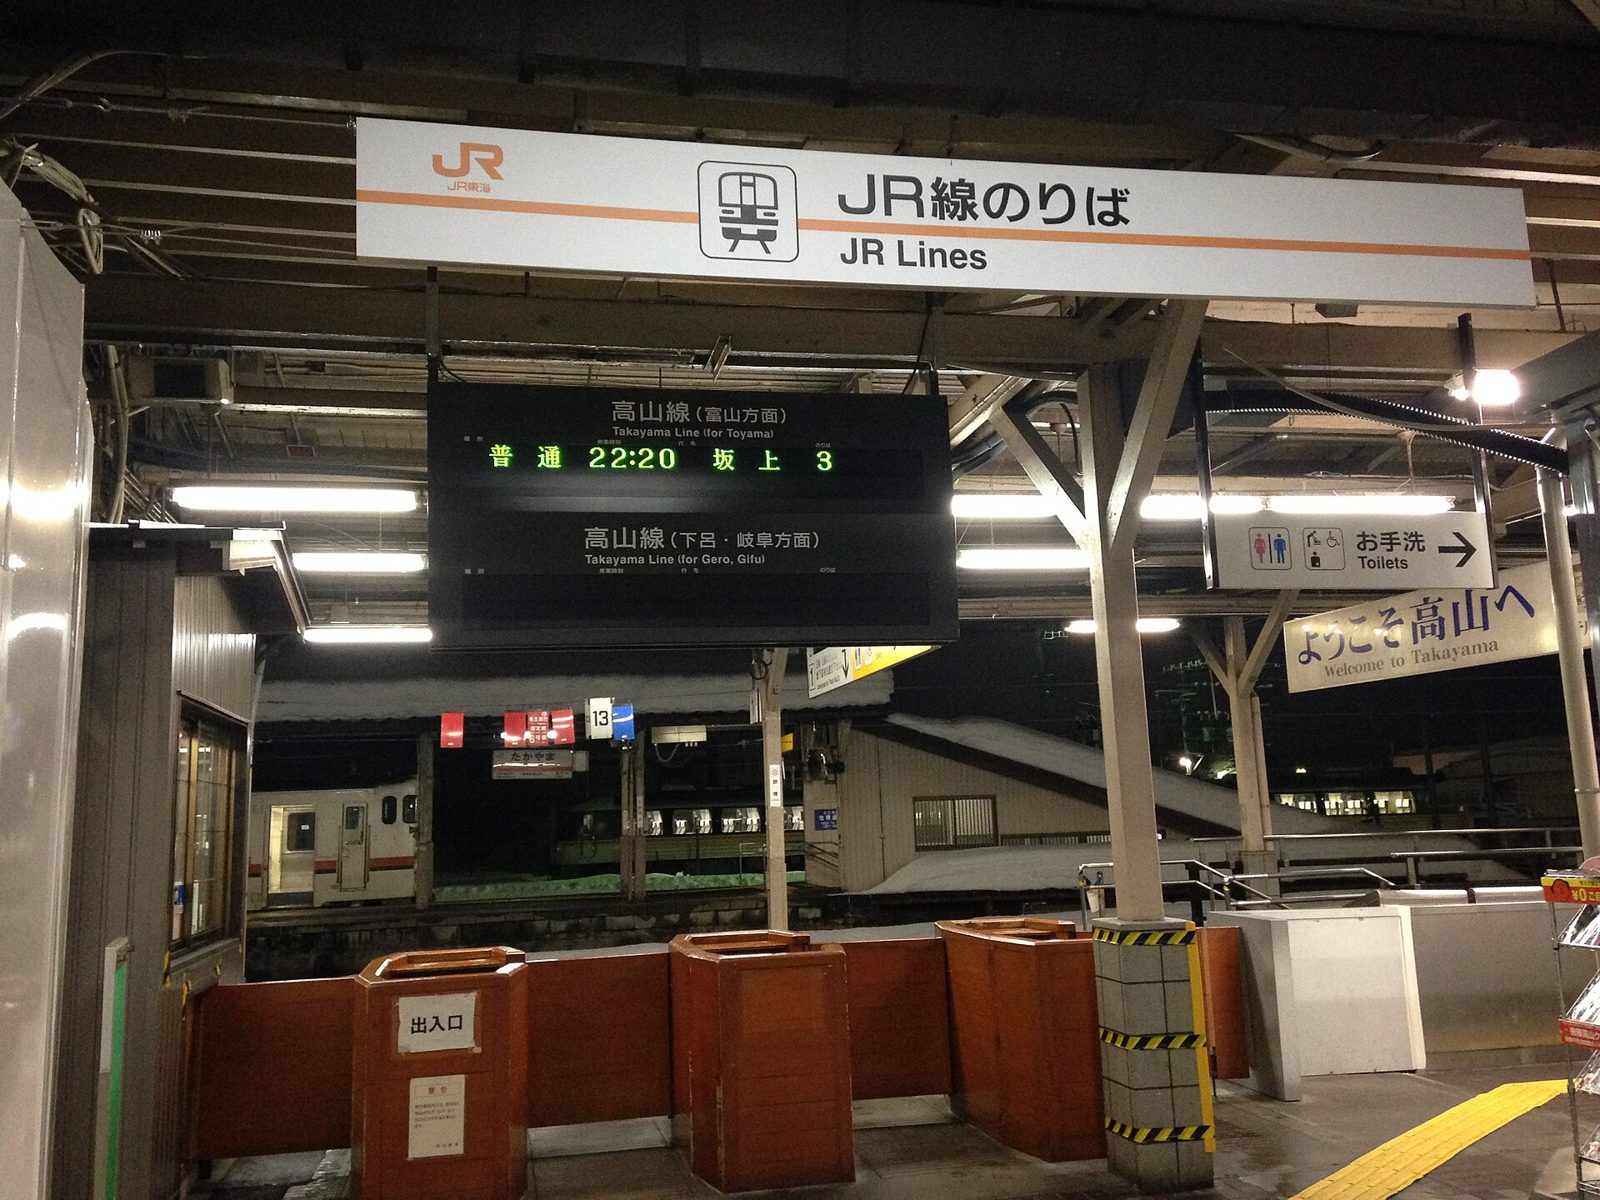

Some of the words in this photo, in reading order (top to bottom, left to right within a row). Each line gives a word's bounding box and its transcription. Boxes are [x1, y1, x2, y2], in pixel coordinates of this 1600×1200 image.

[432, 142, 504, 181] JR
[447, 181, 491, 194] JR東海
[837, 173, 1131, 227] JR線のりば
[840, 238, 885, 265] JR
[898, 240, 988, 270] Lines
[611, 400, 787, 424] 高山線（富山方面）
[613, 426, 671, 439] Takayama
[675, 427, 700, 438] Line
[703, 428, 723, 438] (for
[727, 428, 774, 440] Toyama)
[489, 444, 562, 469] 普通
[589, 447, 677, 470] 22:20
[713, 447, 781, 471] 坂上
[816, 450, 833, 472] 3
[1356, 530, 1426, 553] お手洗
[585, 554, 645, 567] Takayama
[649, 555, 675, 565] Line
[678, 555, 698, 566] (for
[701, 554, 734, 567] Gero,
[737, 554, 765, 566] Gifu)
[1358, 556, 1409, 570] Toilets
[1298, 584, 1536, 665] ようこそ高山へ
[1325, 660, 1385, 679] Welcome
[1390, 655, 1406, 669] to
[1411, 638, 1500, 666] Takayama
[592, 710, 609, 727] 13
[411, 1014, 464, 1035] 出入口
